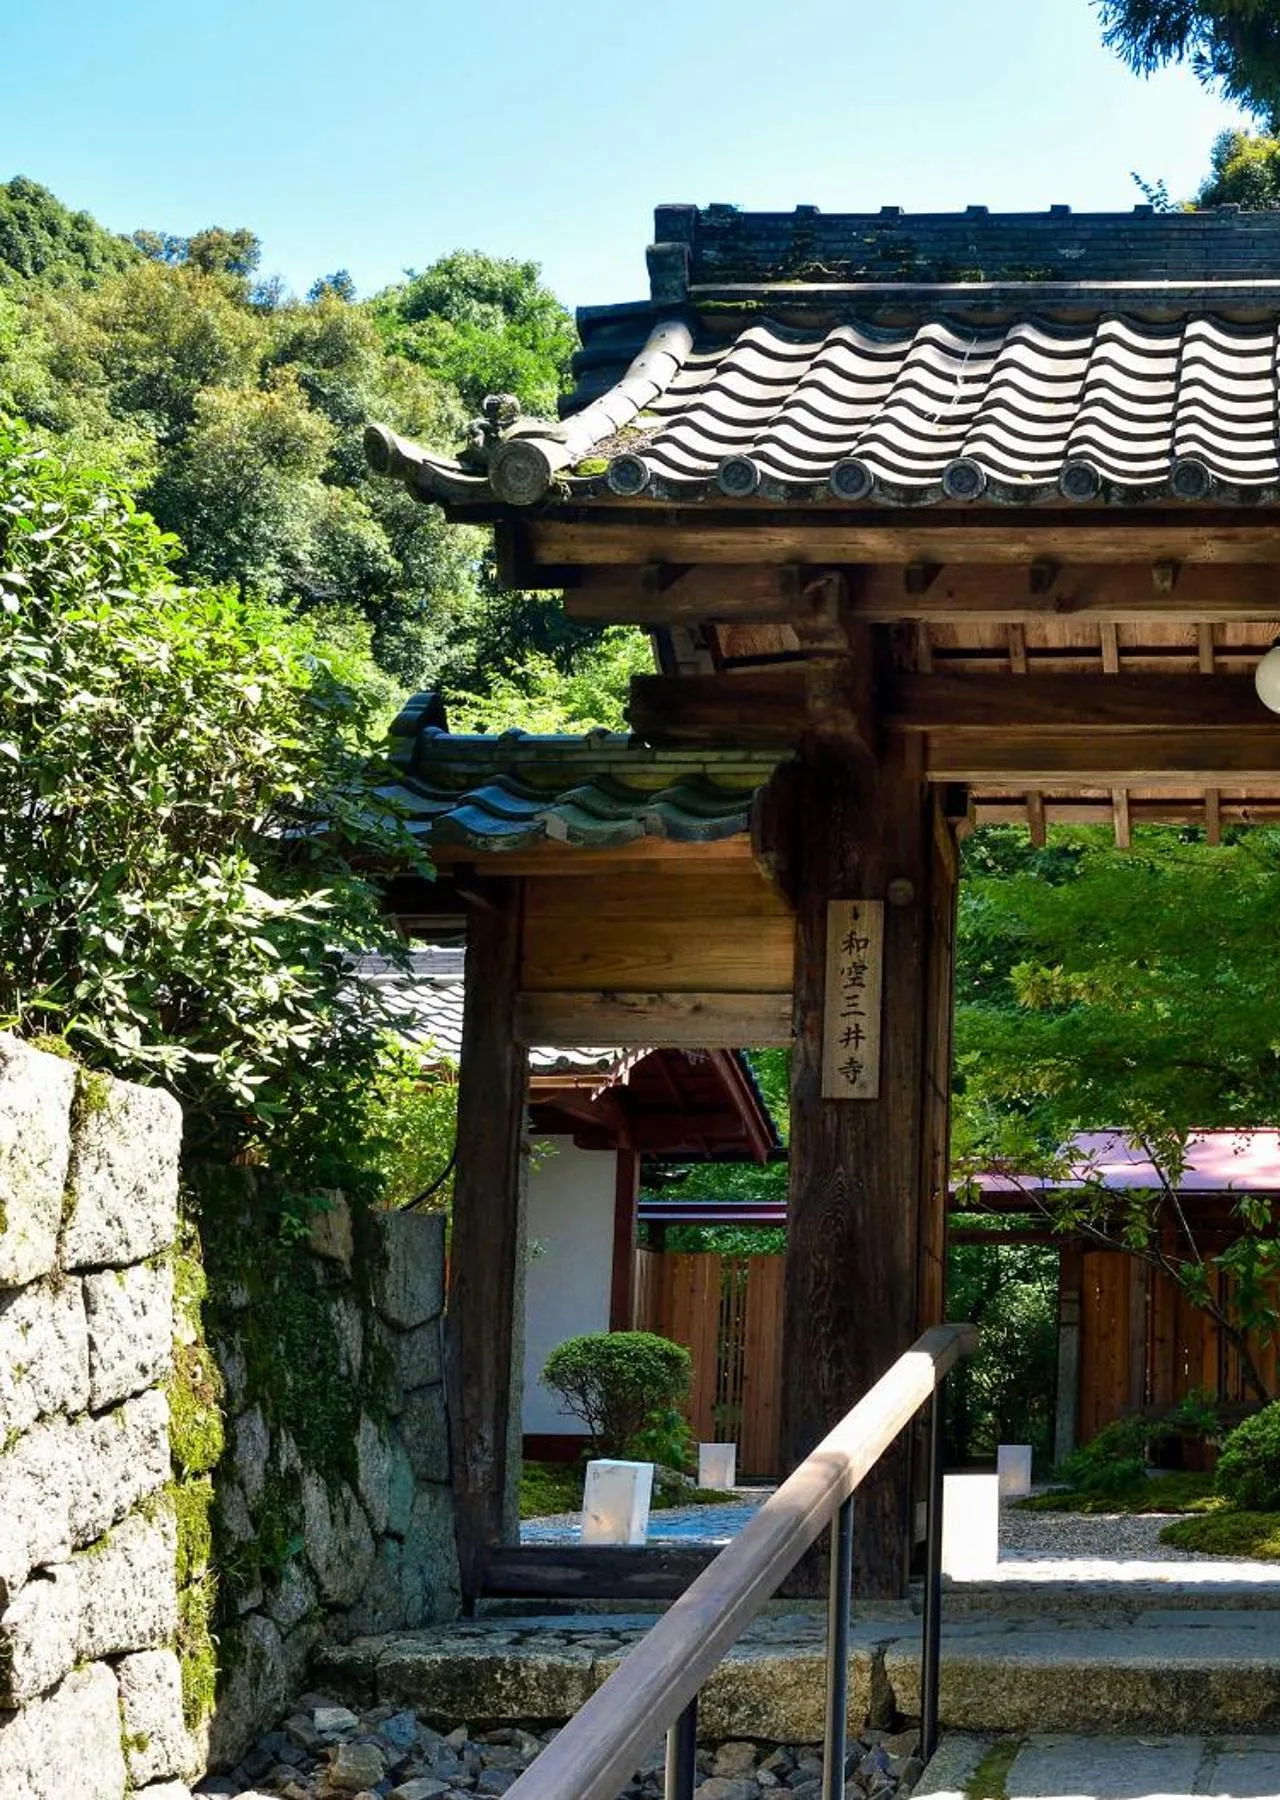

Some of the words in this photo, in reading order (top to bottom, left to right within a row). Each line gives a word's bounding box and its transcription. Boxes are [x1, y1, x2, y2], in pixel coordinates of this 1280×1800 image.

[838, 931, 870, 1086] 和空三井寺
